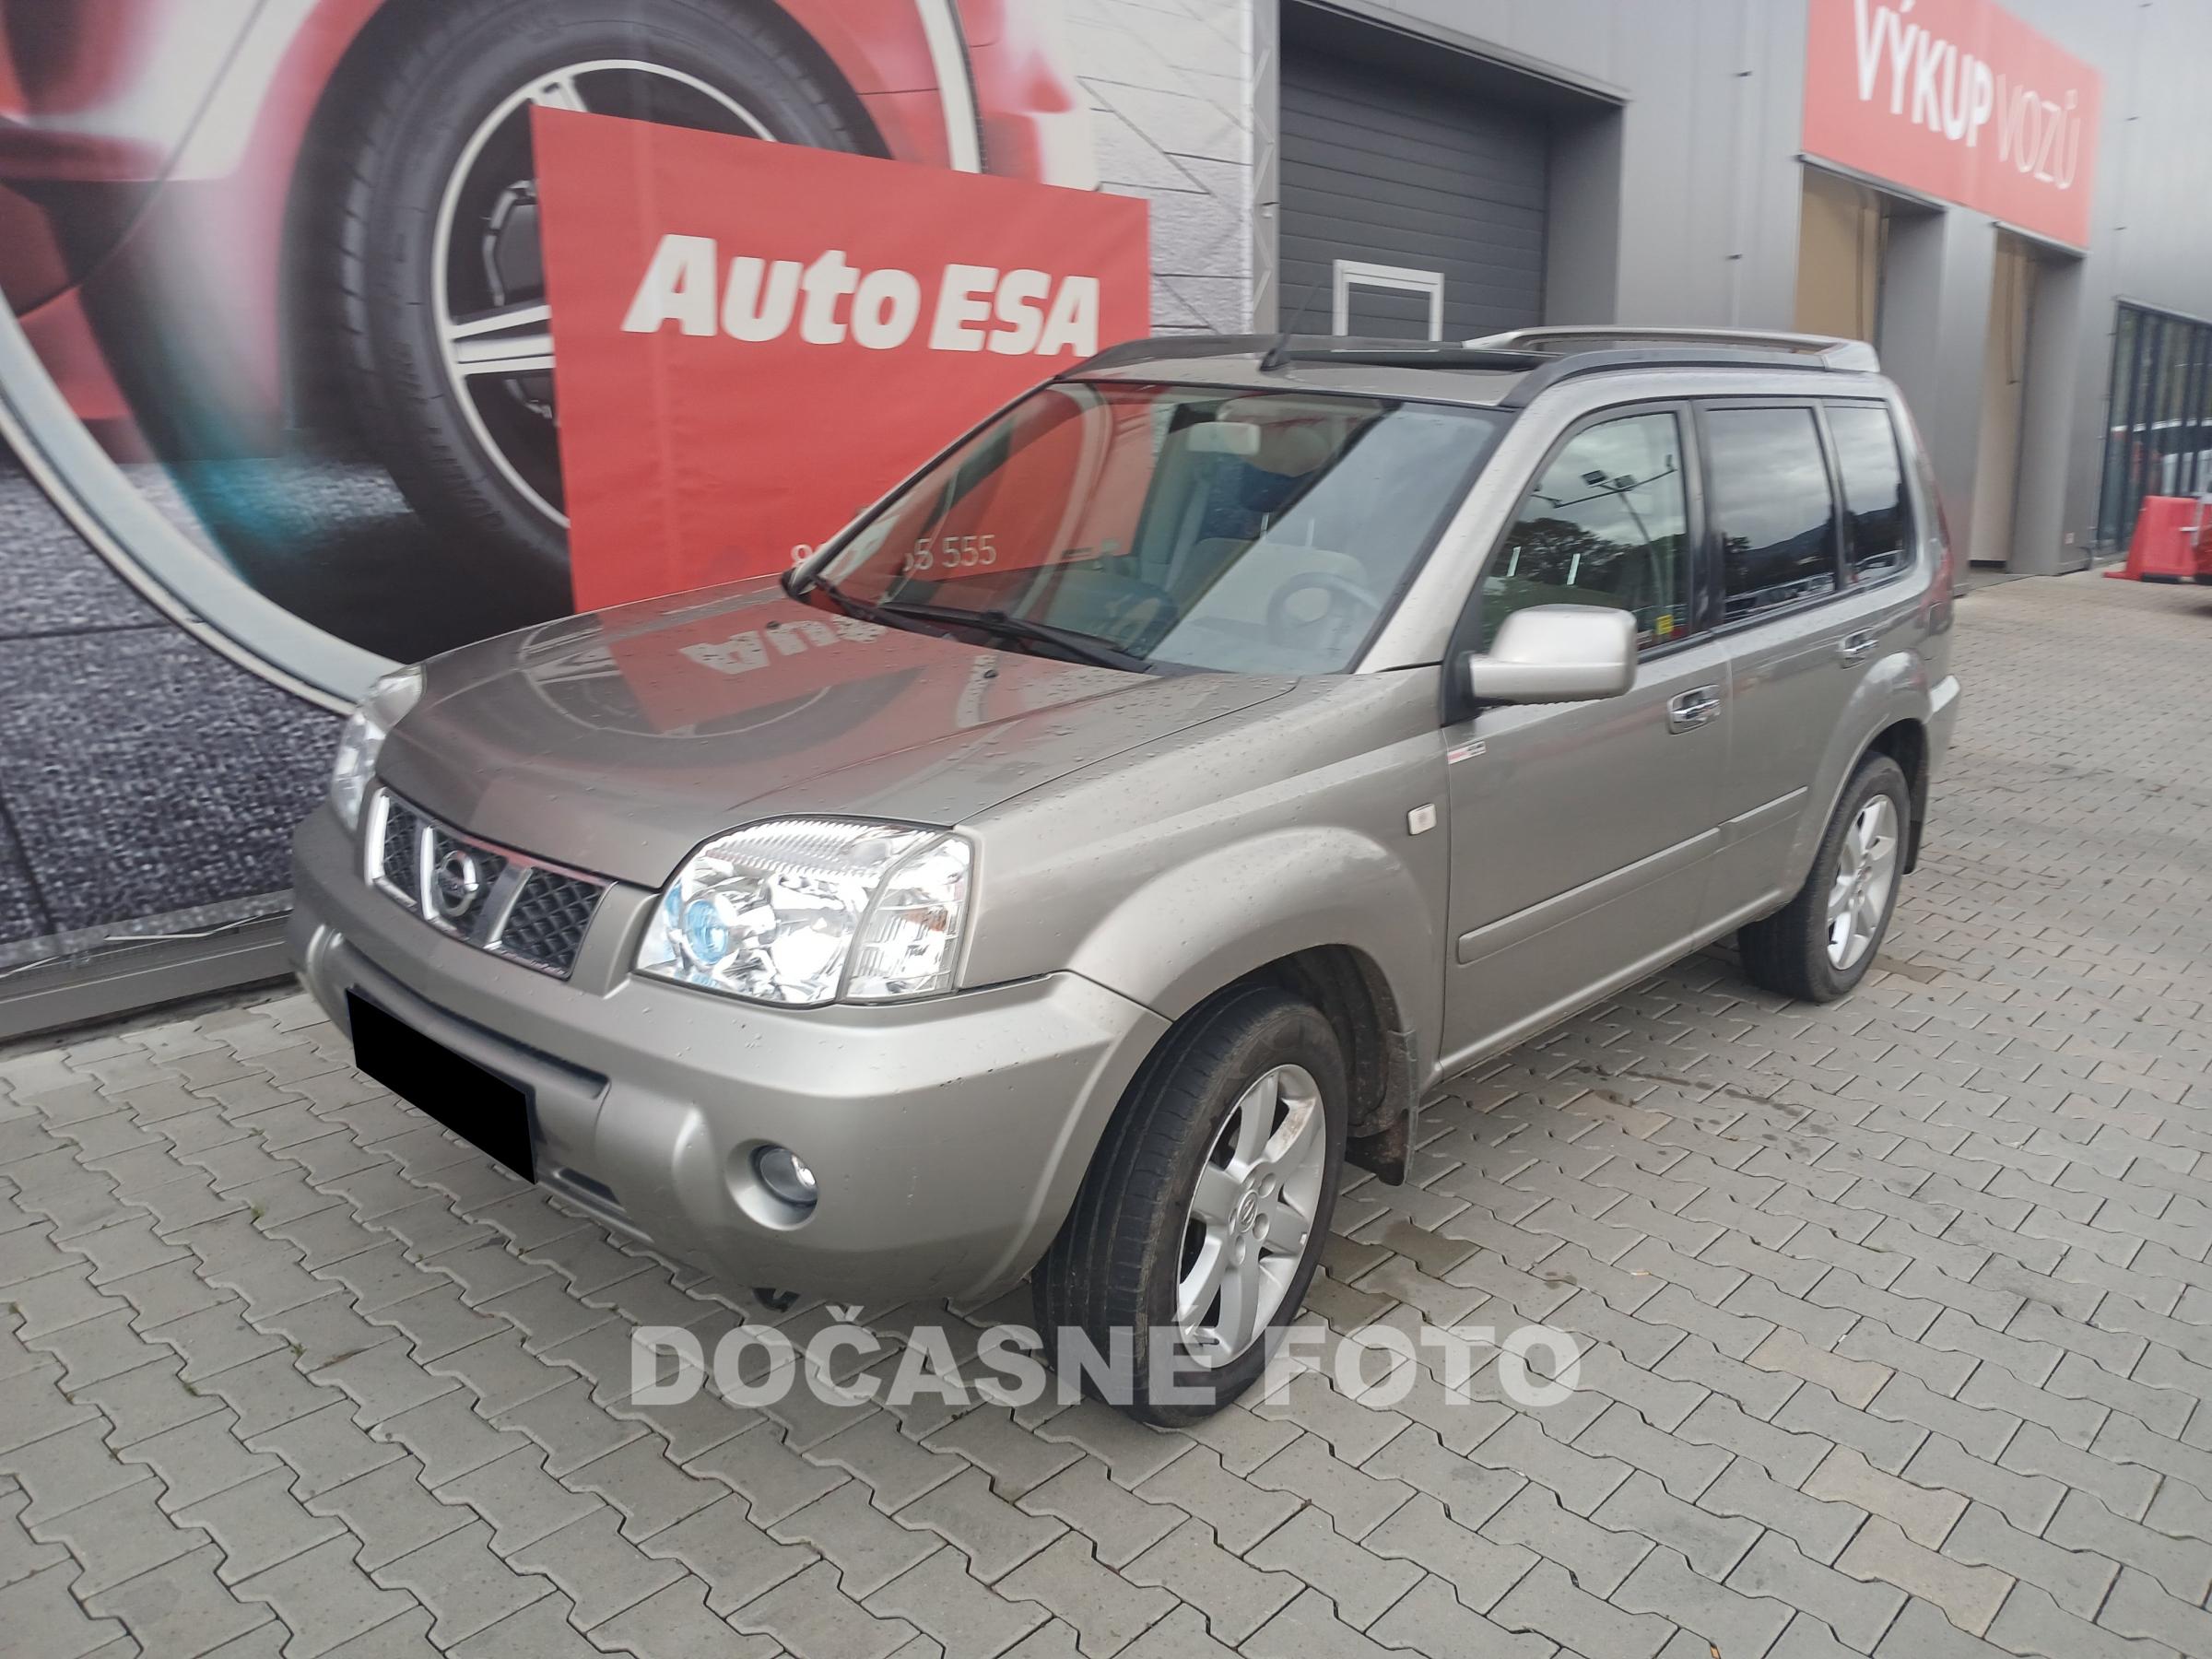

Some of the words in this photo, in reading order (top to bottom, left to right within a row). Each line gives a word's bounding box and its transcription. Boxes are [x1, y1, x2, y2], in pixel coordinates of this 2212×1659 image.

[1853, 0, 1994, 147] VÝKUP
[620, 232, 922, 349] Auto
[927, 263, 1100, 358] ESA
[941, 534, 997, 569] 555
